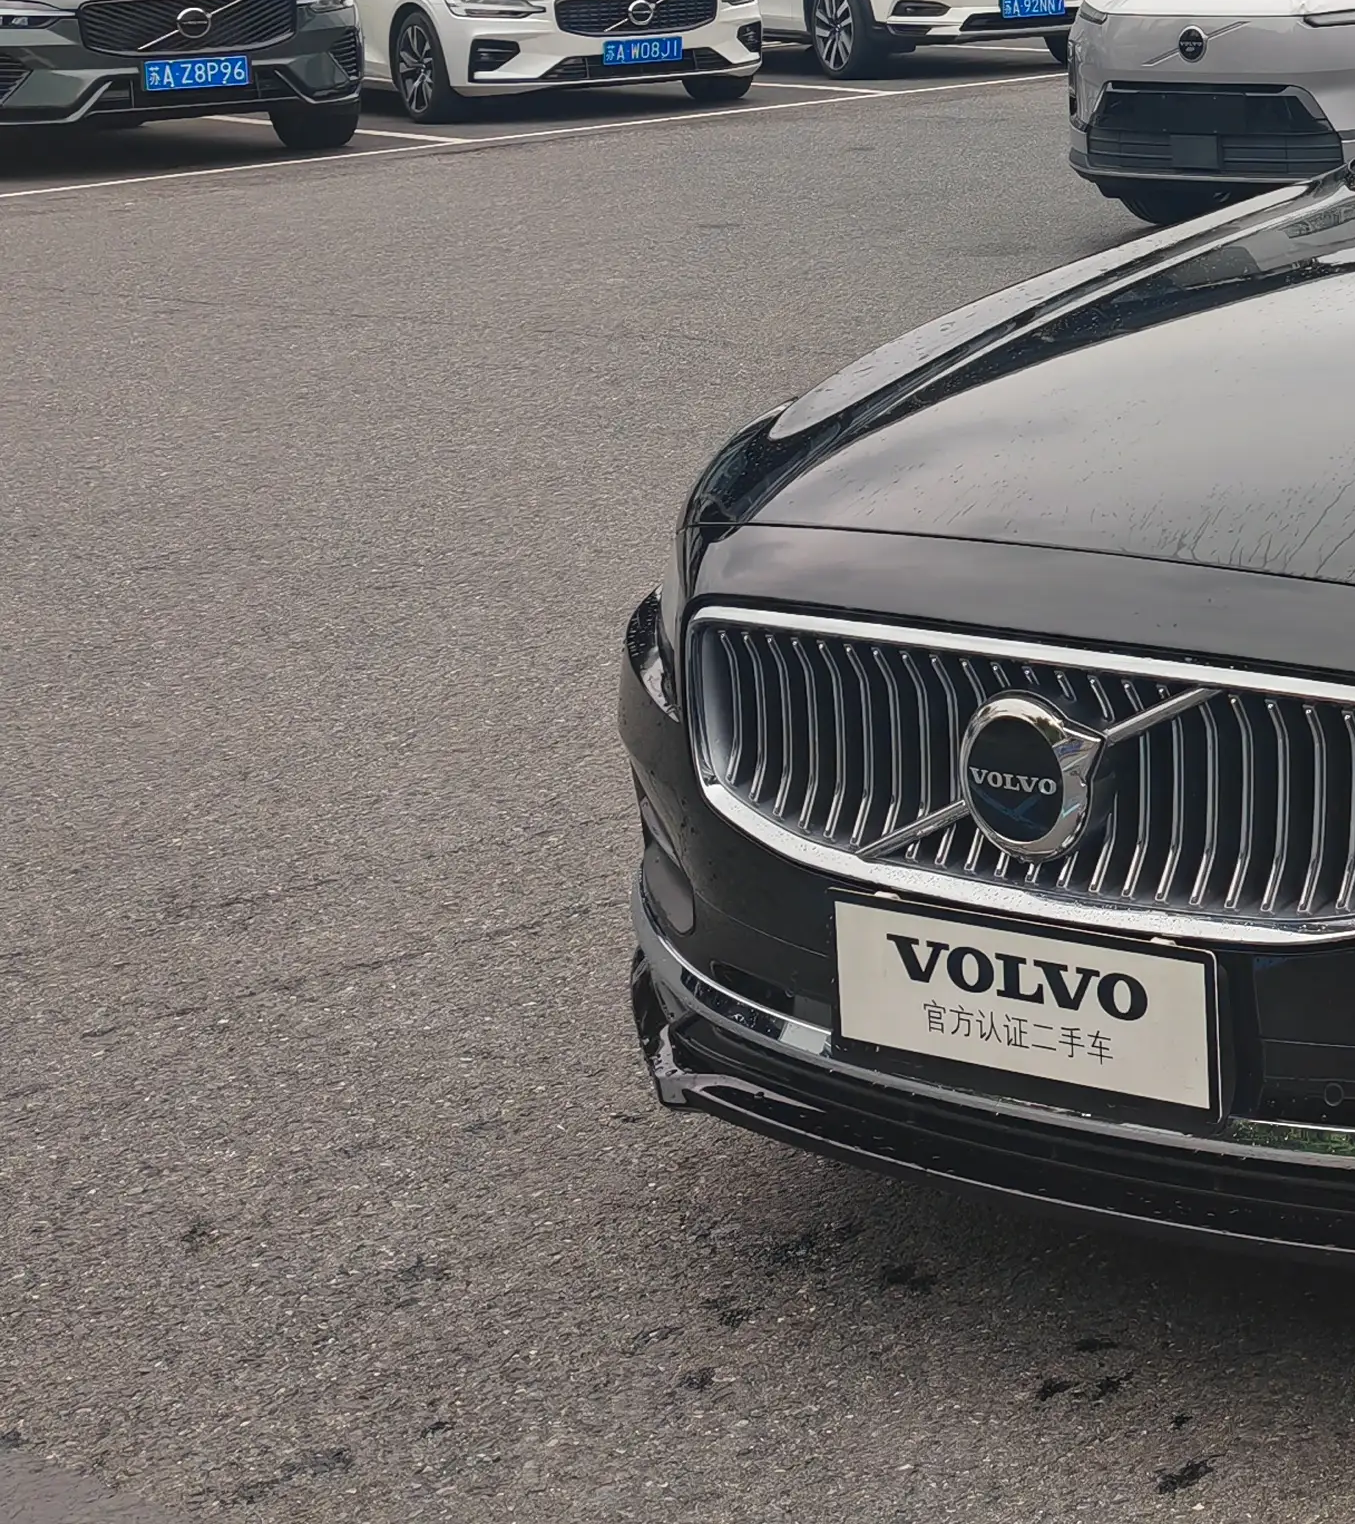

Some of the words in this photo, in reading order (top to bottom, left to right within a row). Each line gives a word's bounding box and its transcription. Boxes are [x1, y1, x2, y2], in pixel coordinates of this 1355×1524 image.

[969, 766, 1057, 795] VOLVO
[886, 933, 1148, 1021] VOLVO
[923, 999, 1114, 1066] 官方认证二手车
